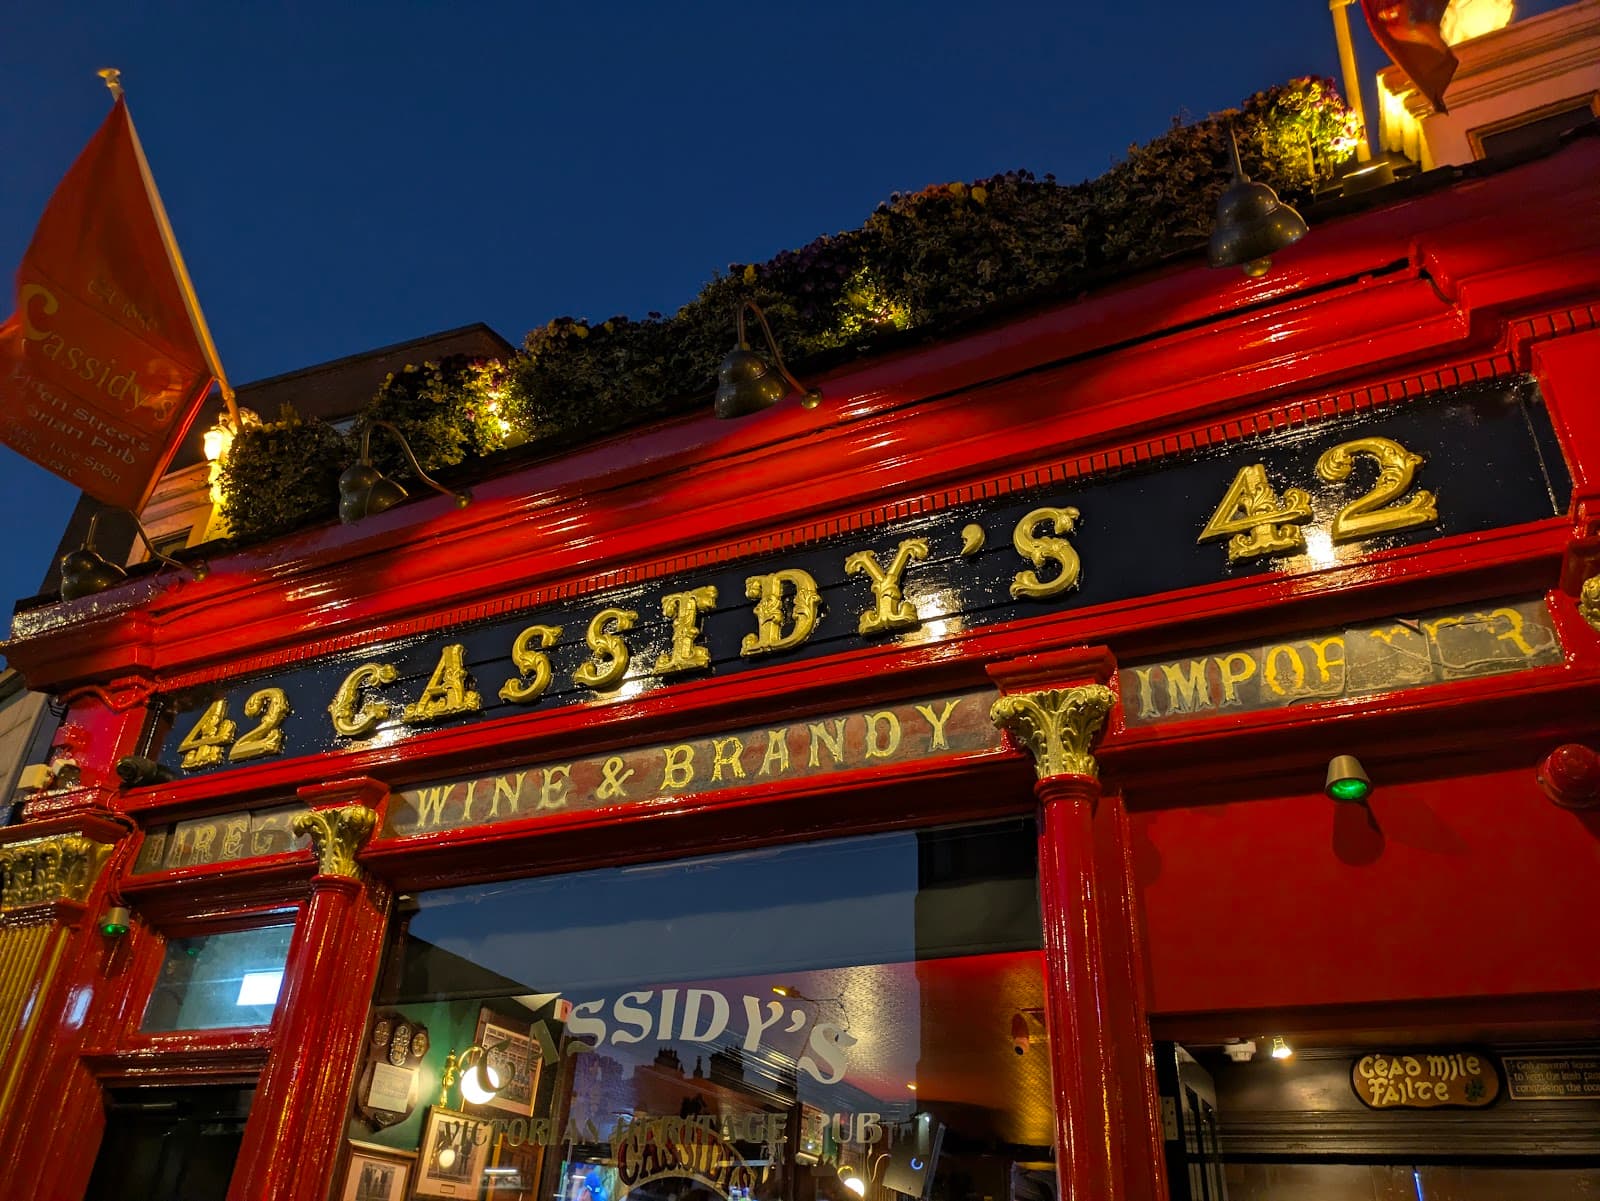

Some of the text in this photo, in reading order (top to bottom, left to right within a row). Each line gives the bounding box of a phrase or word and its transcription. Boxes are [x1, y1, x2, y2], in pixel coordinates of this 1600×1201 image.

[91, 436, 136, 465] Pub
[177, 437, 1438, 770] 42 CASSIDY'S 42
[416, 698, 962, 828] WINE & BRANDY
[477, 988, 858, 1093] CASSIDY'S
[444, 1116, 601, 1148] VICTORIAN
[809, 1111, 883, 1145] PUB
